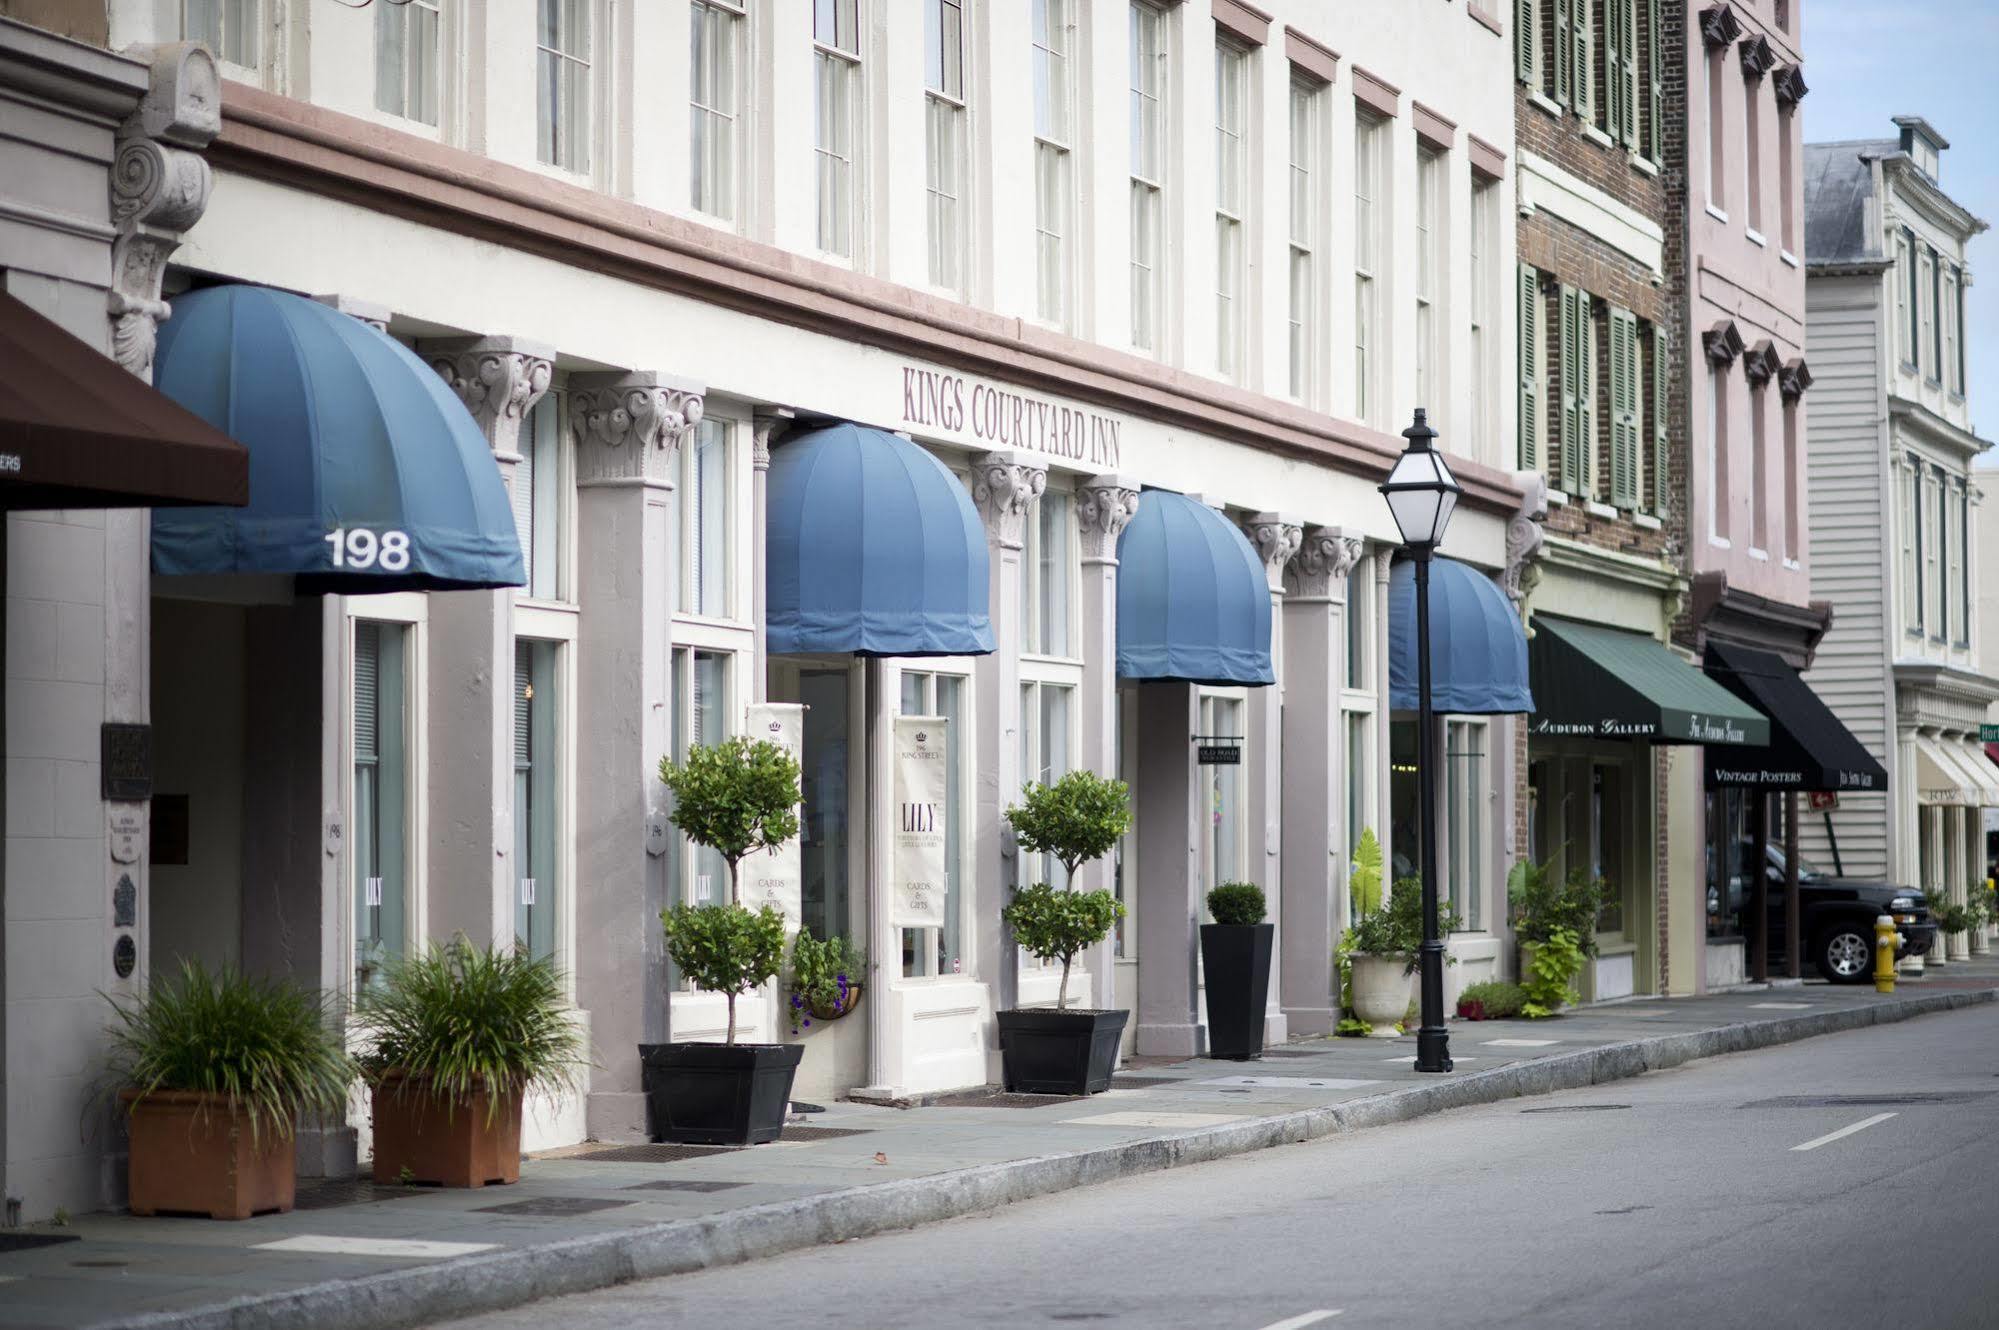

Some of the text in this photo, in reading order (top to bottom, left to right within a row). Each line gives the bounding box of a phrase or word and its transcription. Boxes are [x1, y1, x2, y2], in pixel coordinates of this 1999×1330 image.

[903, 366, 1121, 468] KINGS COURTYARD INN
[325, 528, 410, 571] 198
[1528, 717, 1656, 734] AUDUBON GALLERY
[901, 751, 940, 760] KING STREET
[1715, 769, 1802, 784] VINTAGE POSTERS
[902, 802, 938, 832] LILY
[758, 879, 785, 888] CARDS
[906, 881, 932, 891] CARDS
[910, 900, 929, 911] GIFTS
